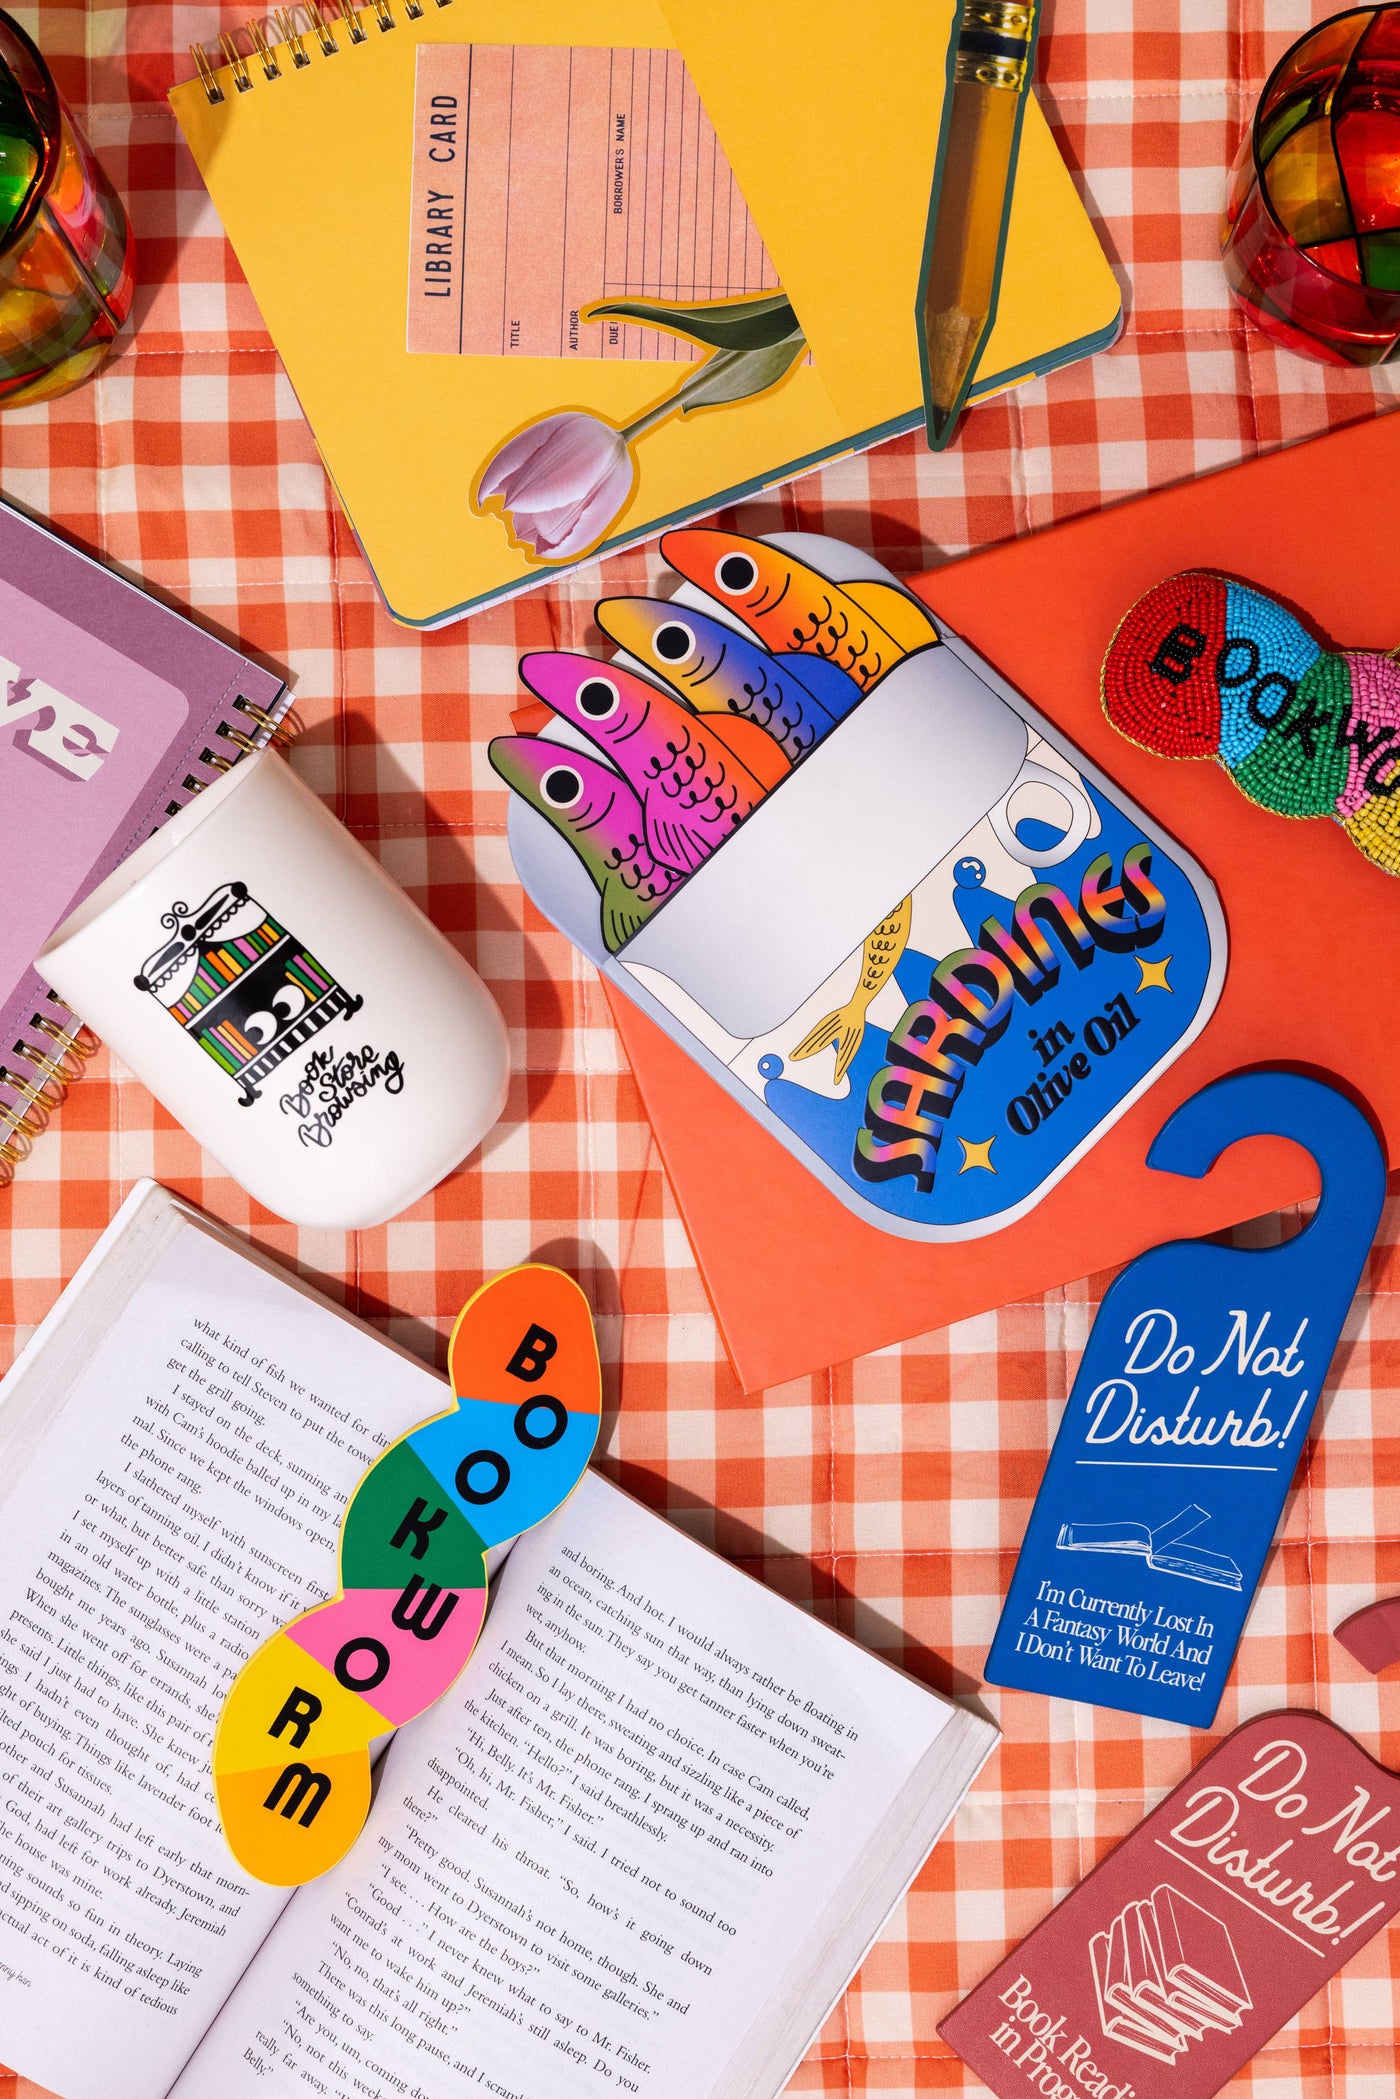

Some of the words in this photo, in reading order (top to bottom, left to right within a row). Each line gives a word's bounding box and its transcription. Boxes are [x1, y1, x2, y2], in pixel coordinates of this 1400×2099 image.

[428, 95, 458, 163] CARD
[616, 113, 627, 142] NAME
[613, 148, 625, 214] BORROWER'S
[424, 190, 454, 297] LIBRARY
[510, 319, 521, 348] TITLE
[569, 310, 579, 351] AUTHOR
[608, 325, 619, 345] DUE
[852, 842, 1167, 1194] SARDINES
[1028, 1019, 1076, 1068] in
[279, 1045, 334, 1118] Book
[298, 1050, 405, 1148] Browsing
[318, 1044, 380, 1103] Store
[1005, 1052, 1092, 1136] Olive
[1082, 992, 1141, 1057] Oil
[1124, 1308, 1196, 1375] Do
[1200, 1310, 1309, 1377] Not
[165, 1357, 187, 1374] get
[187, 1368, 207, 1386] the
[205, 1383, 234, 1403] grill
[230, 1399, 265, 1427] going.
[1085, 1379, 1309, 1449] Disturb!
[120, 1433, 139, 1451] the
[137, 1447, 175, 1474] phone
[175, 1471, 202, 1495] rang.
[171, 1383, 180, 1395] I
[179, 1392, 216, 1418] stayed
[215, 1415, 231, 1430] on
[233, 1425, 253, 1443] the
[255, 1439, 283, 1466] deck,
[285, 1461, 332, 1496] sunning
[131, 1415, 156, 1436] mal.
[156, 1428, 187, 1455] Since
[189, 1451, 205, 1467] we
[205, 1460, 232, 1485] kept
[232, 1479, 252, 1497] the
[254, 1494, 303, 1531] windows
[304, 1527, 336, 1554] open,
[123, 1461, 132, 1473] I
[131, 1468, 182, 1505] slathered
[181, 1503, 222, 1530] myself
[221, 1527, 246, 1549] with
[248, 1546, 303, 1585] sunscreen
[305, 1580, 330, 1600] first
[525, 1603, 543, 1625] wet,
[544, 1619, 587, 1654] anyhow.
[560, 1546, 582, 1563] and
[579, 1555, 615, 1591] boring.
[616, 1583, 644, 1607] And
[642, 1599, 665, 1623] hot.
[667, 1615, 676, 1628] I
[677, 1624, 715, 1652] would
[713, 1648, 751, 1675] always
[751, 1671, 786, 1697] rather
[786, 1689, 802, 1707] be
[802, 1700, 846, 1736] floating
[845, 1725, 859, 1742] in
[1023, 1607, 1040, 1628] A
[1043, 1612, 1111, 1645] Fantasy
[1117, 1625, 1169, 1656] World
[1171, 1637, 1213, 1666] And
[1035, 1580, 1064, 1606] I'm
[1068, 1587, 1153, 1627] Currently
[1154, 1605, 1194, 1634] Lost
[1195, 1617, 1214, 1638] In
[548, 1565, 561, 1578] an
[562, 1575, 593, 1604] ocean,
[595, 1599, 643, 1637] catching
[642, 1631, 665, 1649] sun
[667, 1644, 691, 1665] that
[693, 1661, 717, 1684] way,
[718, 1677, 744, 1699] than
[745, 1691, 776, 1720] lying
[776, 1712, 809, 1739] down
[810, 1735, 846, 1759] sweat-
[1015, 1631, 1024, 1652] I
[1024, 1635, 1073, 1664] Don't
[1079, 1645, 1122, 1675] Want
[1124, 1655, 1147, 1678] To
[1147, 1660, 1206, 1692] Leave!
[524, 1629, 545, 1651] But
[544, 1645, 567, 1667] that
[566, 1663, 617, 1703] morning
[616, 1693, 626, 1705] I
[624, 1698, 650, 1720] had
[647, 1716, 665, 1731] no
[666, 1727, 705, 1758] choice.
[706, 1749, 721, 1766] In
[721, 1762, 746, 1781] case
[747, 1775, 775, 1799] Cam
[775, 1795, 811, 1822] called,
[486, 1743, 516, 1773] Belly.
[535, 1778, 556, 1801] Mr.
[1, 1771, 20, 1784] of
[17, 1780, 45, 1803] their
[45, 1801, 63, 1817] art
[62, 1815, 104, 1845] gallery
[106, 1840, 133, 1862] trips
[135, 1858, 149, 1871] to
[152, 1865, 215, 1910] Dyerstown,
[218, 1903, 242, 1917] and
[29, 1763, 54, 1782] and
[53, 1776, 106, 1817] Susannah
[108, 1811, 134, 1833] had
[133, 1827, 155, 1848] left
[157, 1845, 187, 1867] early
[189, 1861, 213, 1880] that
[215, 1876, 250, 1896] morn-
[1238, 1739, 1308, 1819] Do
[1301, 1785, 1400, 1883] Not
[1170, 1785, 1386, 1946] Disturb!
[66, 1899, 81, 1912] so
[83, 1907, 105, 1927] fun
[107, 1920, 121, 1937] in
[124, 1932, 164, 1960] theory.
[165, 1951, 204, 1979] Laying
[377, 1835, 394, 1854] my
[393, 1849, 421, 1874] mom
[423, 1871, 450, 1896] went
[451, 1891, 465, 1905] to
[466, 1899, 528, 1947] Dyerstown
[530, 1942, 544, 1956] to
[546, 1952, 571, 1972] visit
[570, 1968, 602, 1991] some
[437, 1856, 472, 1883] good.
[534, 1919, 557, 1937] not
[558, 1930, 593, 1962] home,
[596, 1955, 639, 1988] though.
[641, 1980, 665, 2001] She
[666, 1998, 691, 2015] and
[330, 1913, 352, 1937] want
[351, 1933, 370, 1951] me
[370, 1947, 383, 1961] to
[385, 1958, 414, 1983] wake
[414, 1976, 439, 2001] him
[291, 1971, 341, 2019] something
[341, 2012, 354, 2026] to
[354, 2024, 374, 2042] say.
[989, 2015, 1022, 2057] in
[998, 1974, 1068, 2054] Book
